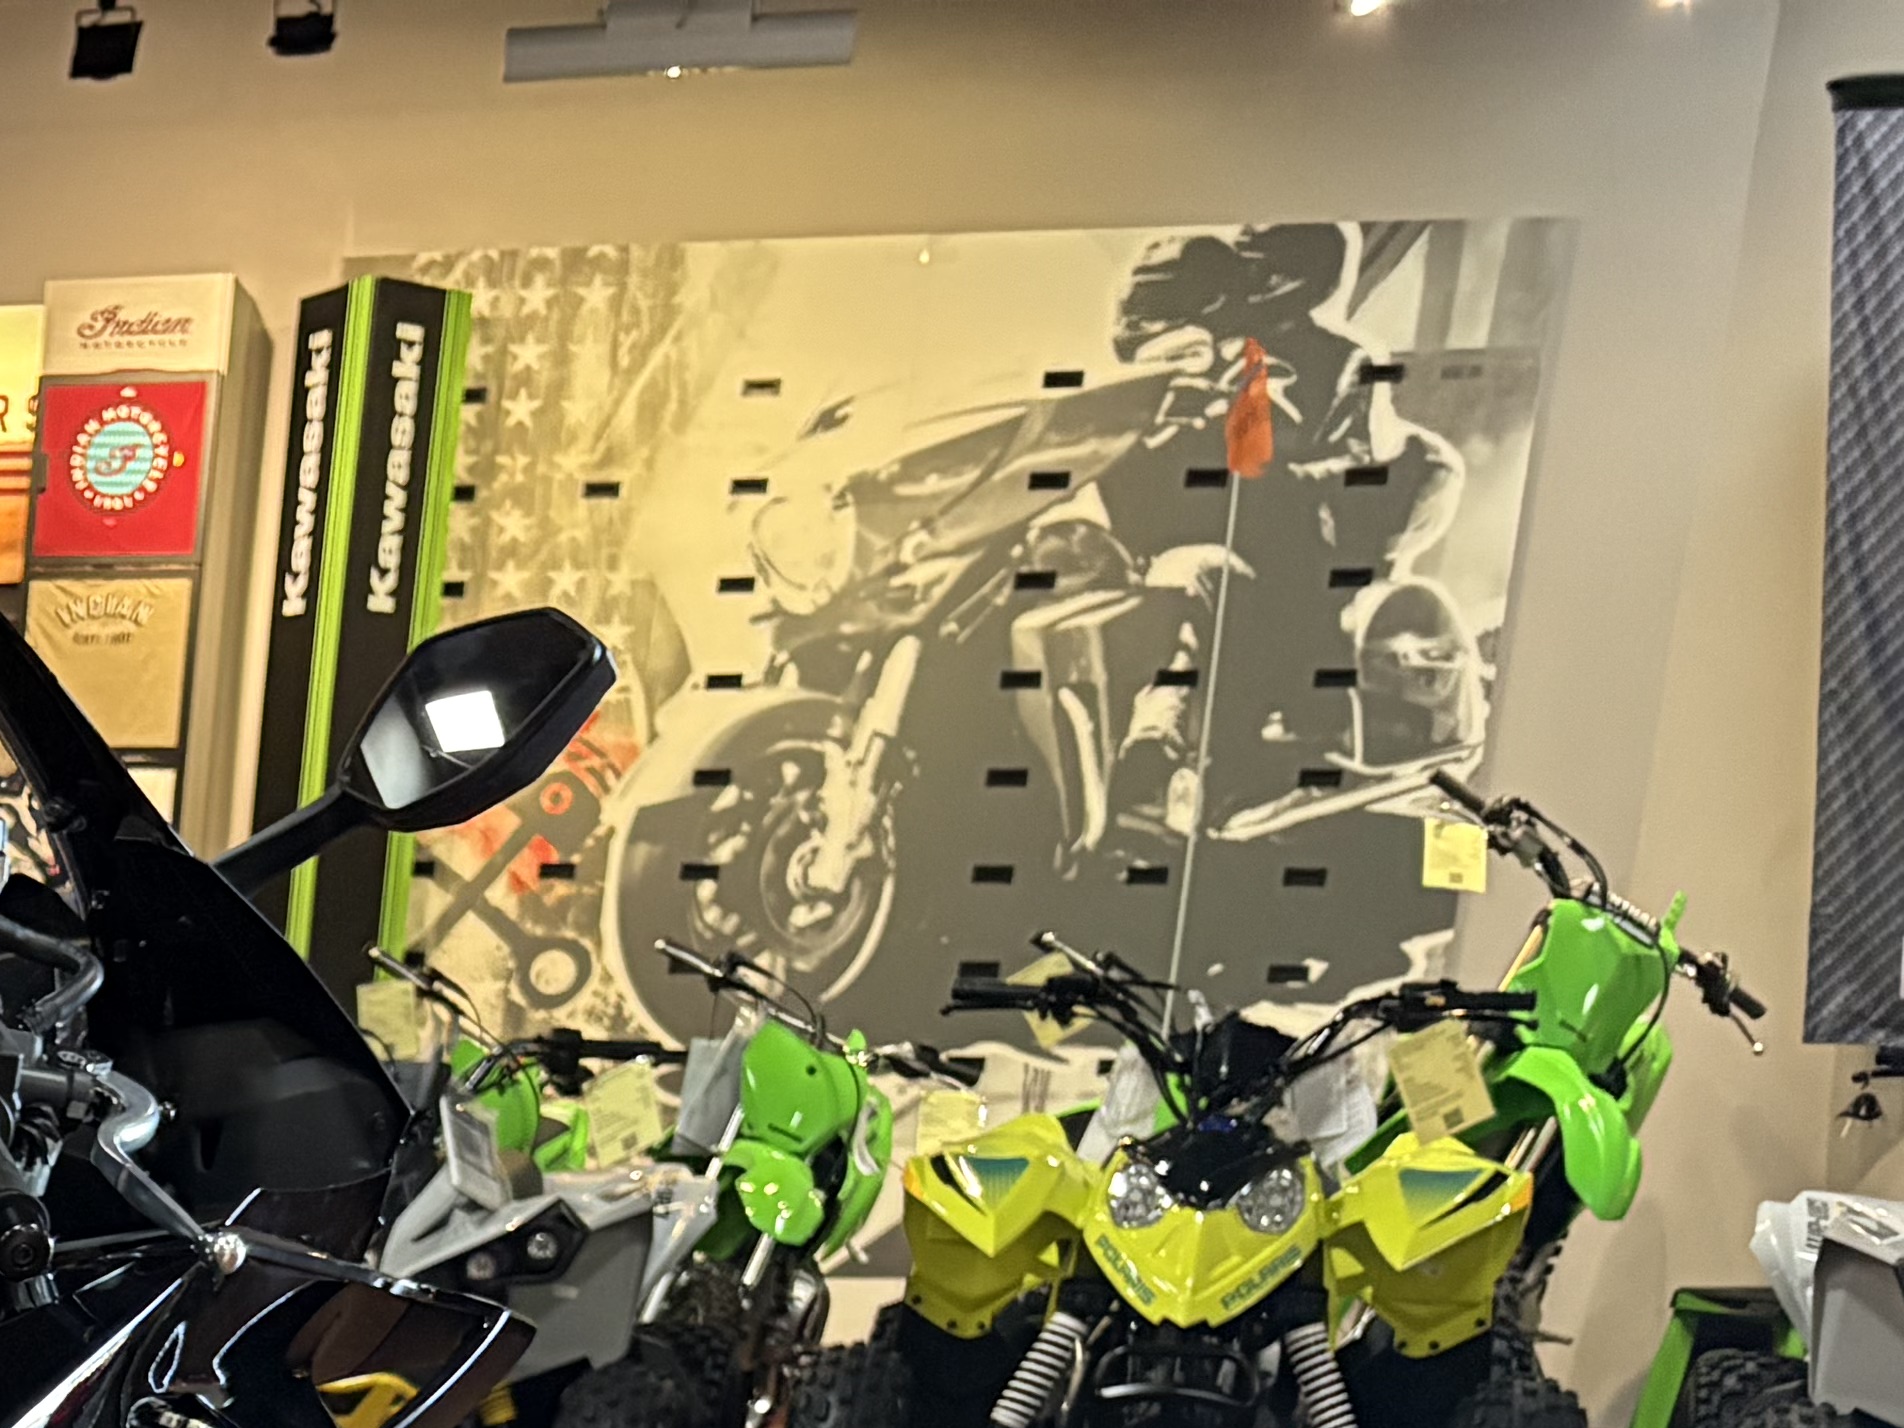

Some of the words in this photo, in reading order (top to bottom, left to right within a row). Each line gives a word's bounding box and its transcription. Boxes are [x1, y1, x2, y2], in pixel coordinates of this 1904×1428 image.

[77, 305, 193, 339] Indian
[282, 328, 334, 617] Kawasaki
[367, 321, 426, 613] Kawasaki
[56, 593, 154, 629] INDIAN
[1221, 1244, 1302, 1311] POLARIS
